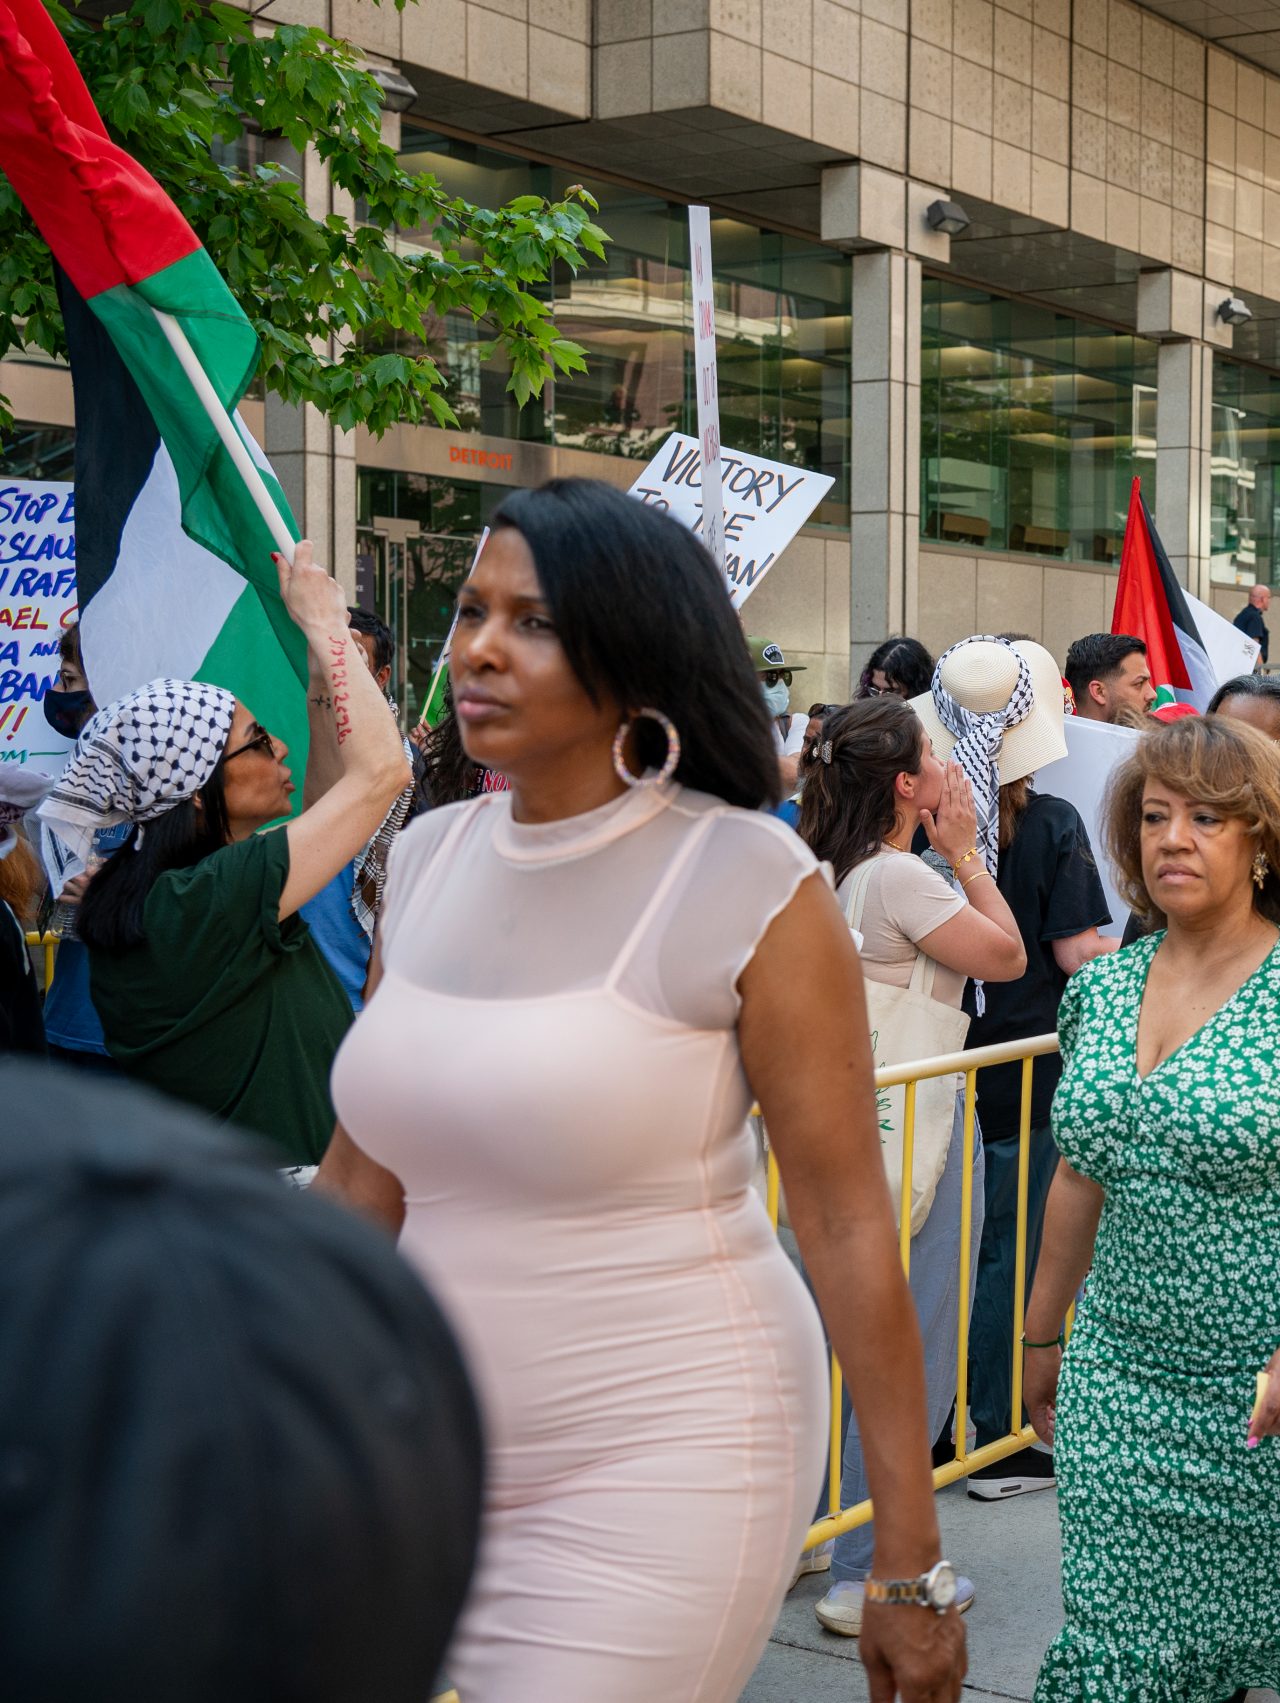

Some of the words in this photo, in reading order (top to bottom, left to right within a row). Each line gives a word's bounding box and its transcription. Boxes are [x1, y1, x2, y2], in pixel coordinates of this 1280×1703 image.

[449, 446, 513, 471] DETROIT
[662, 441, 805, 514] VICTORY
[0, 487, 58, 525] STOP
[691, 503, 756, 543] TE
[726, 553, 775, 587] AN
[0, 640, 20, 667] A
